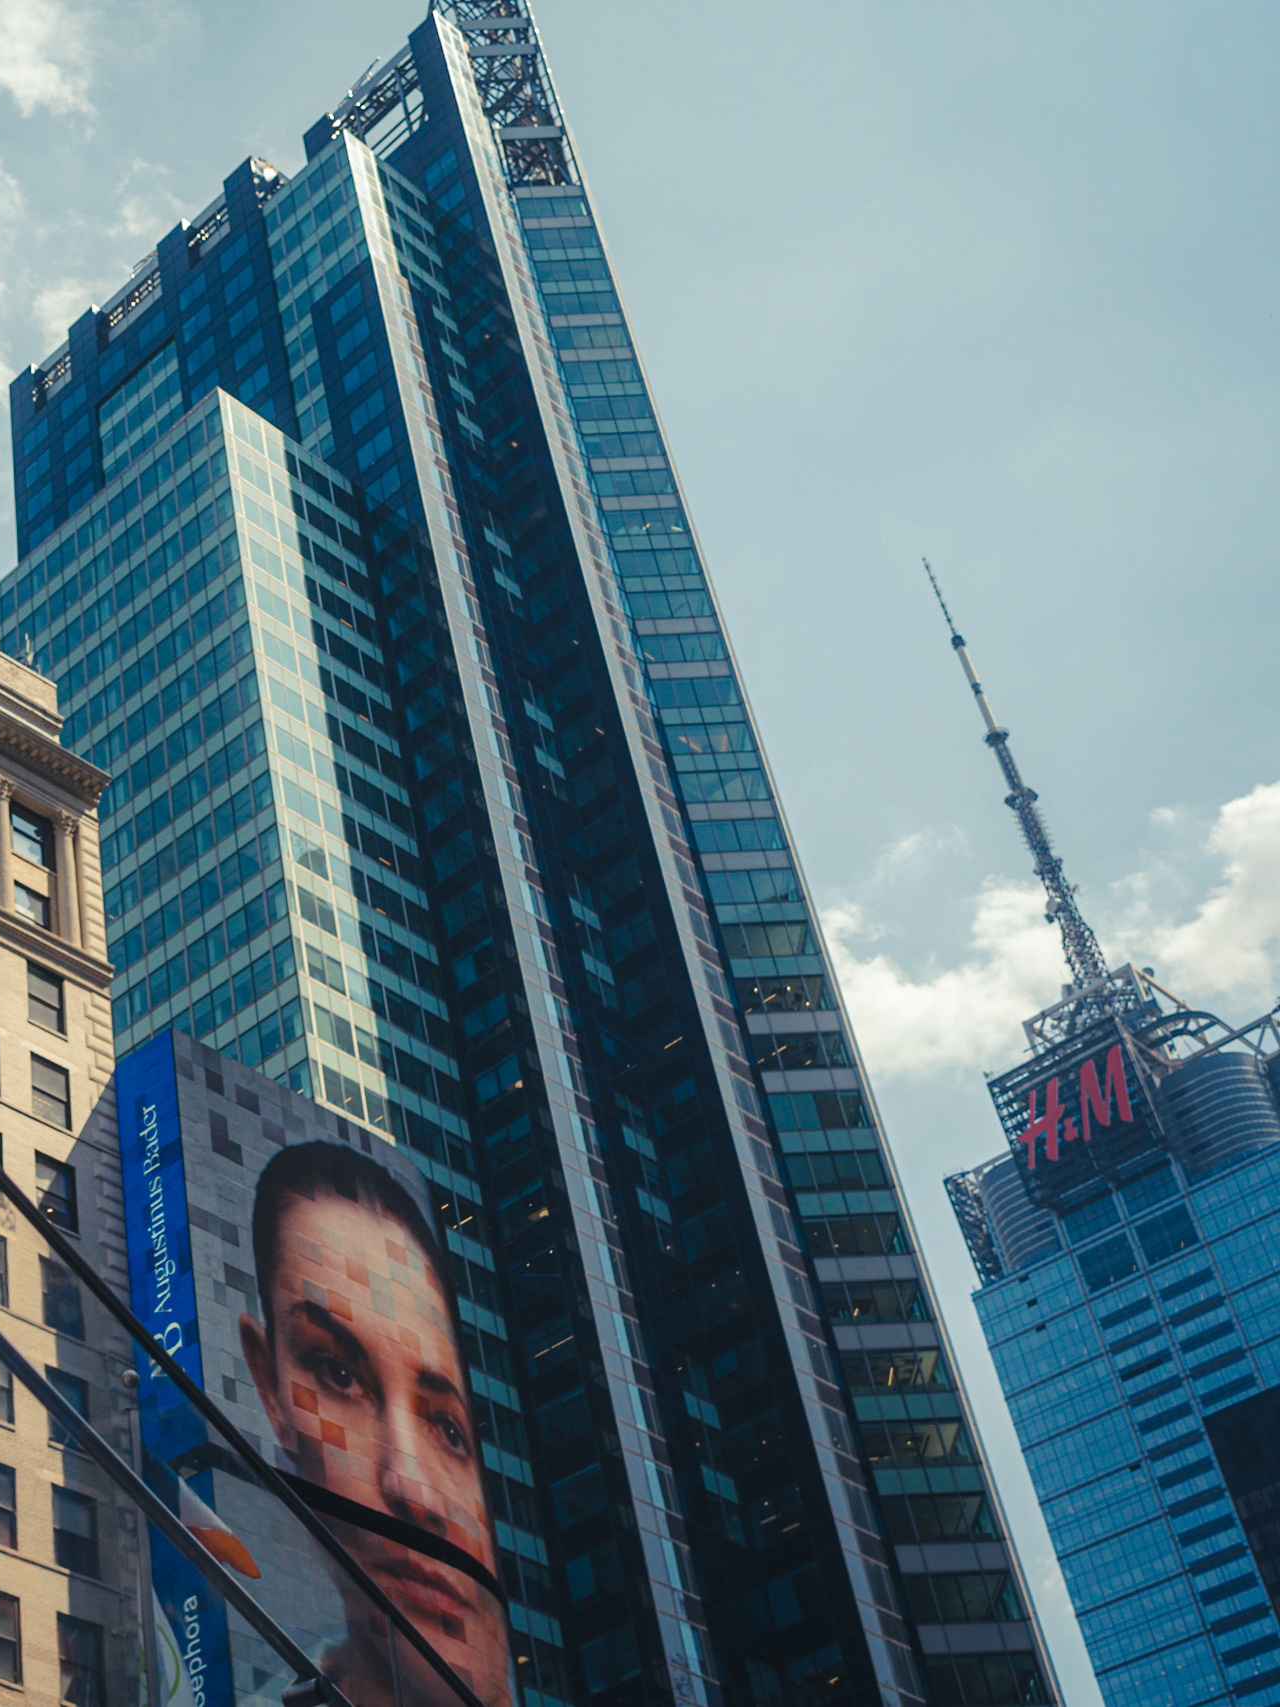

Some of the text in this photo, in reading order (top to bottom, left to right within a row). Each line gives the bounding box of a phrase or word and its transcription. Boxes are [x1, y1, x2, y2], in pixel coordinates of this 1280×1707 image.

[139, 1103, 161, 1176] Bader
[1017, 1043, 1133, 1170] H&M
[147, 1175, 176, 1314] Augustinus
